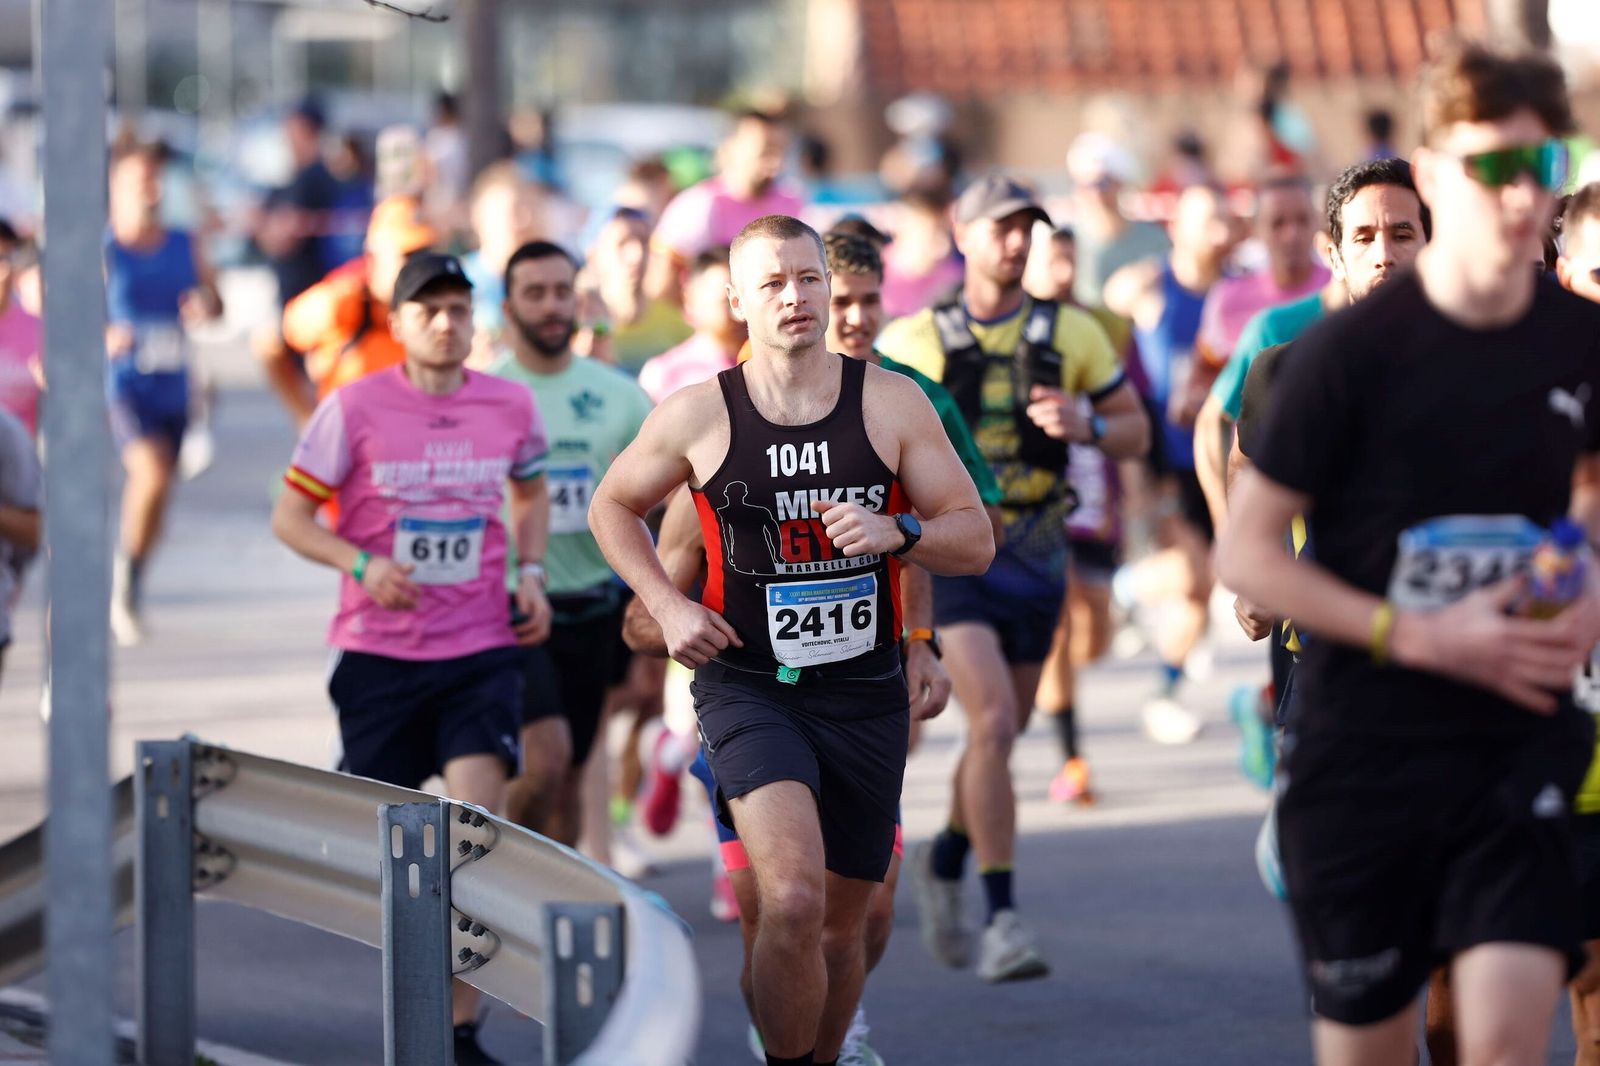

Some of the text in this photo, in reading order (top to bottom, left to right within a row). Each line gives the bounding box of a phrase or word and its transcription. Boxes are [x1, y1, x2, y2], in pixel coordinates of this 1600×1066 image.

[766, 441, 830, 478] 1041
[775, 484, 885, 521] MIKES
[411, 536, 470, 563] 610
[780, 519, 833, 563] GY
[785, 554, 880, 573] MARBELLA.COM
[775, 599, 872, 640] 2416
